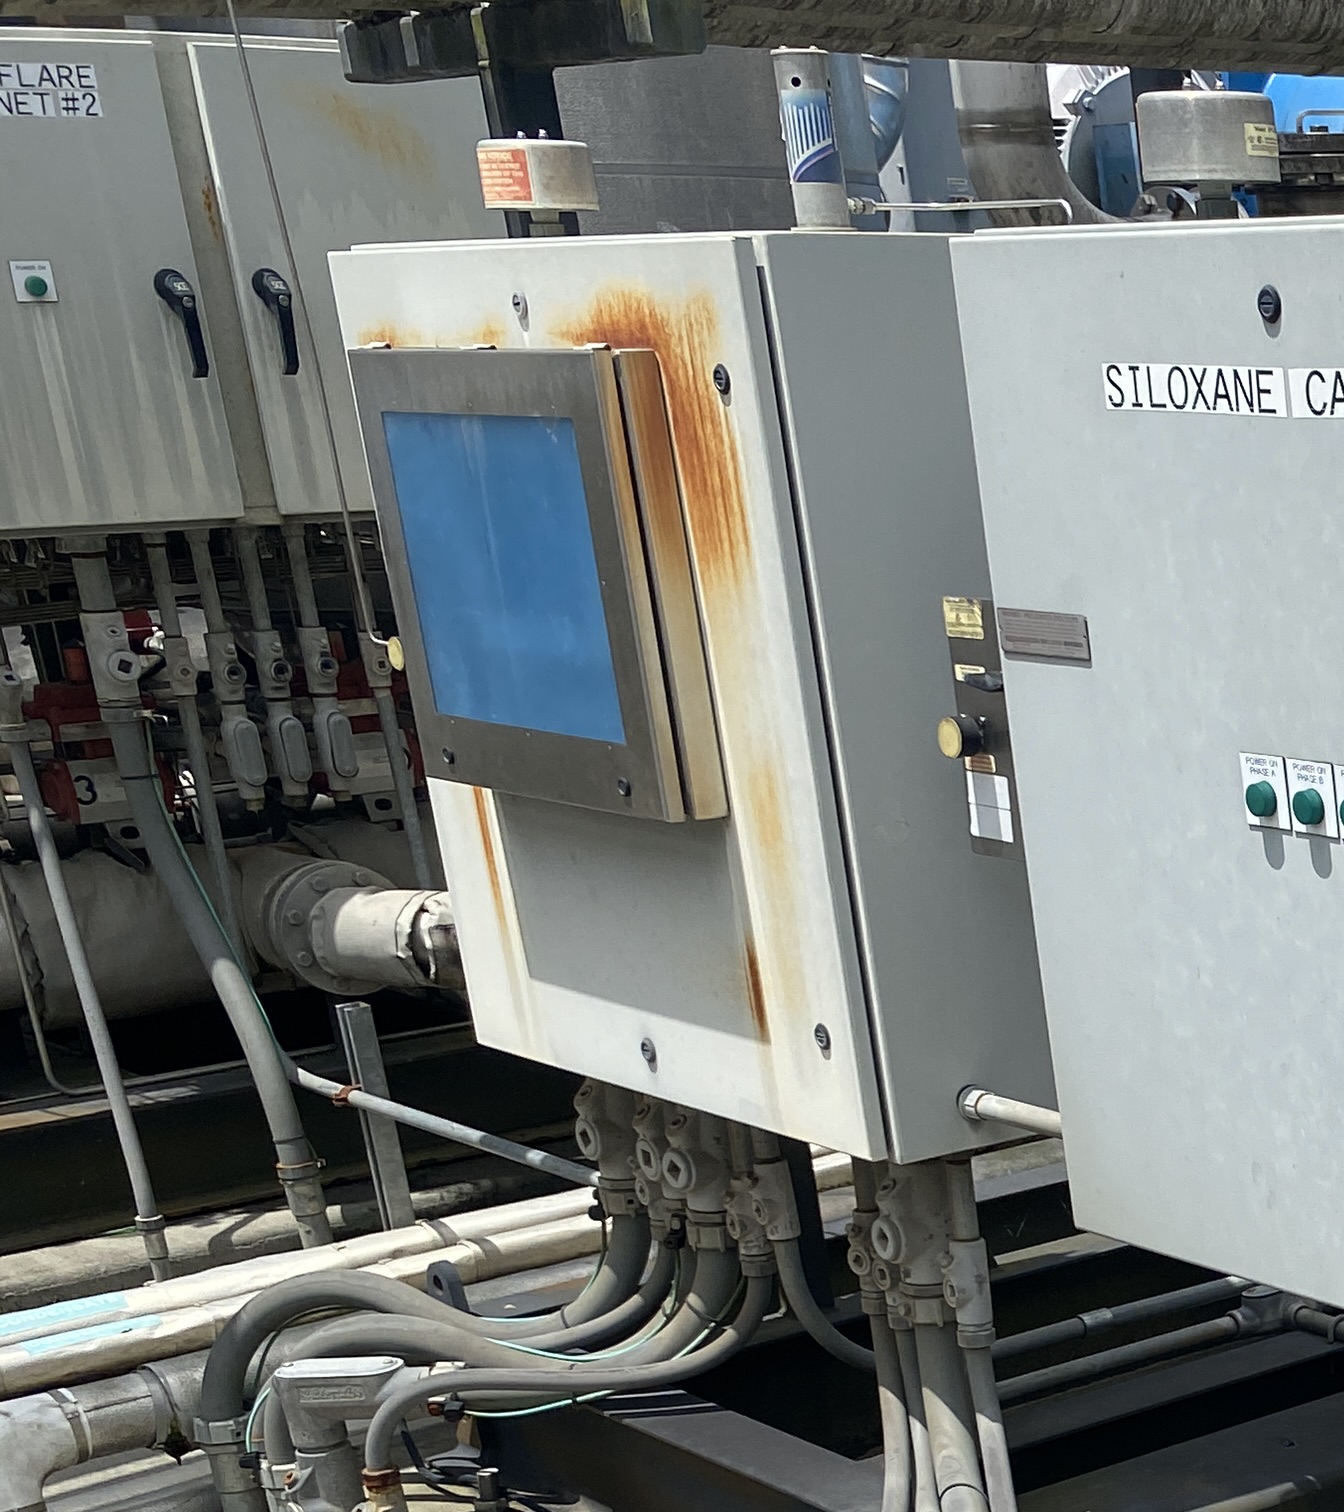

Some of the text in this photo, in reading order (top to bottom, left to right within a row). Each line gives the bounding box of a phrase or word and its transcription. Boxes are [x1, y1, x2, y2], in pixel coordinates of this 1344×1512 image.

[0, 63, 96, 89] FLARE
[61, 92, 98, 117] #2
[1106, 364, 1278, 414] SILOXANE
[1245, 756, 1267, 767] POWER
[1292, 762, 1315, 774] POWER
[1249, 766, 1270, 777] PHASE
[1297, 773, 1317, 784] PHASE
[74, 775, 97, 805] 3
